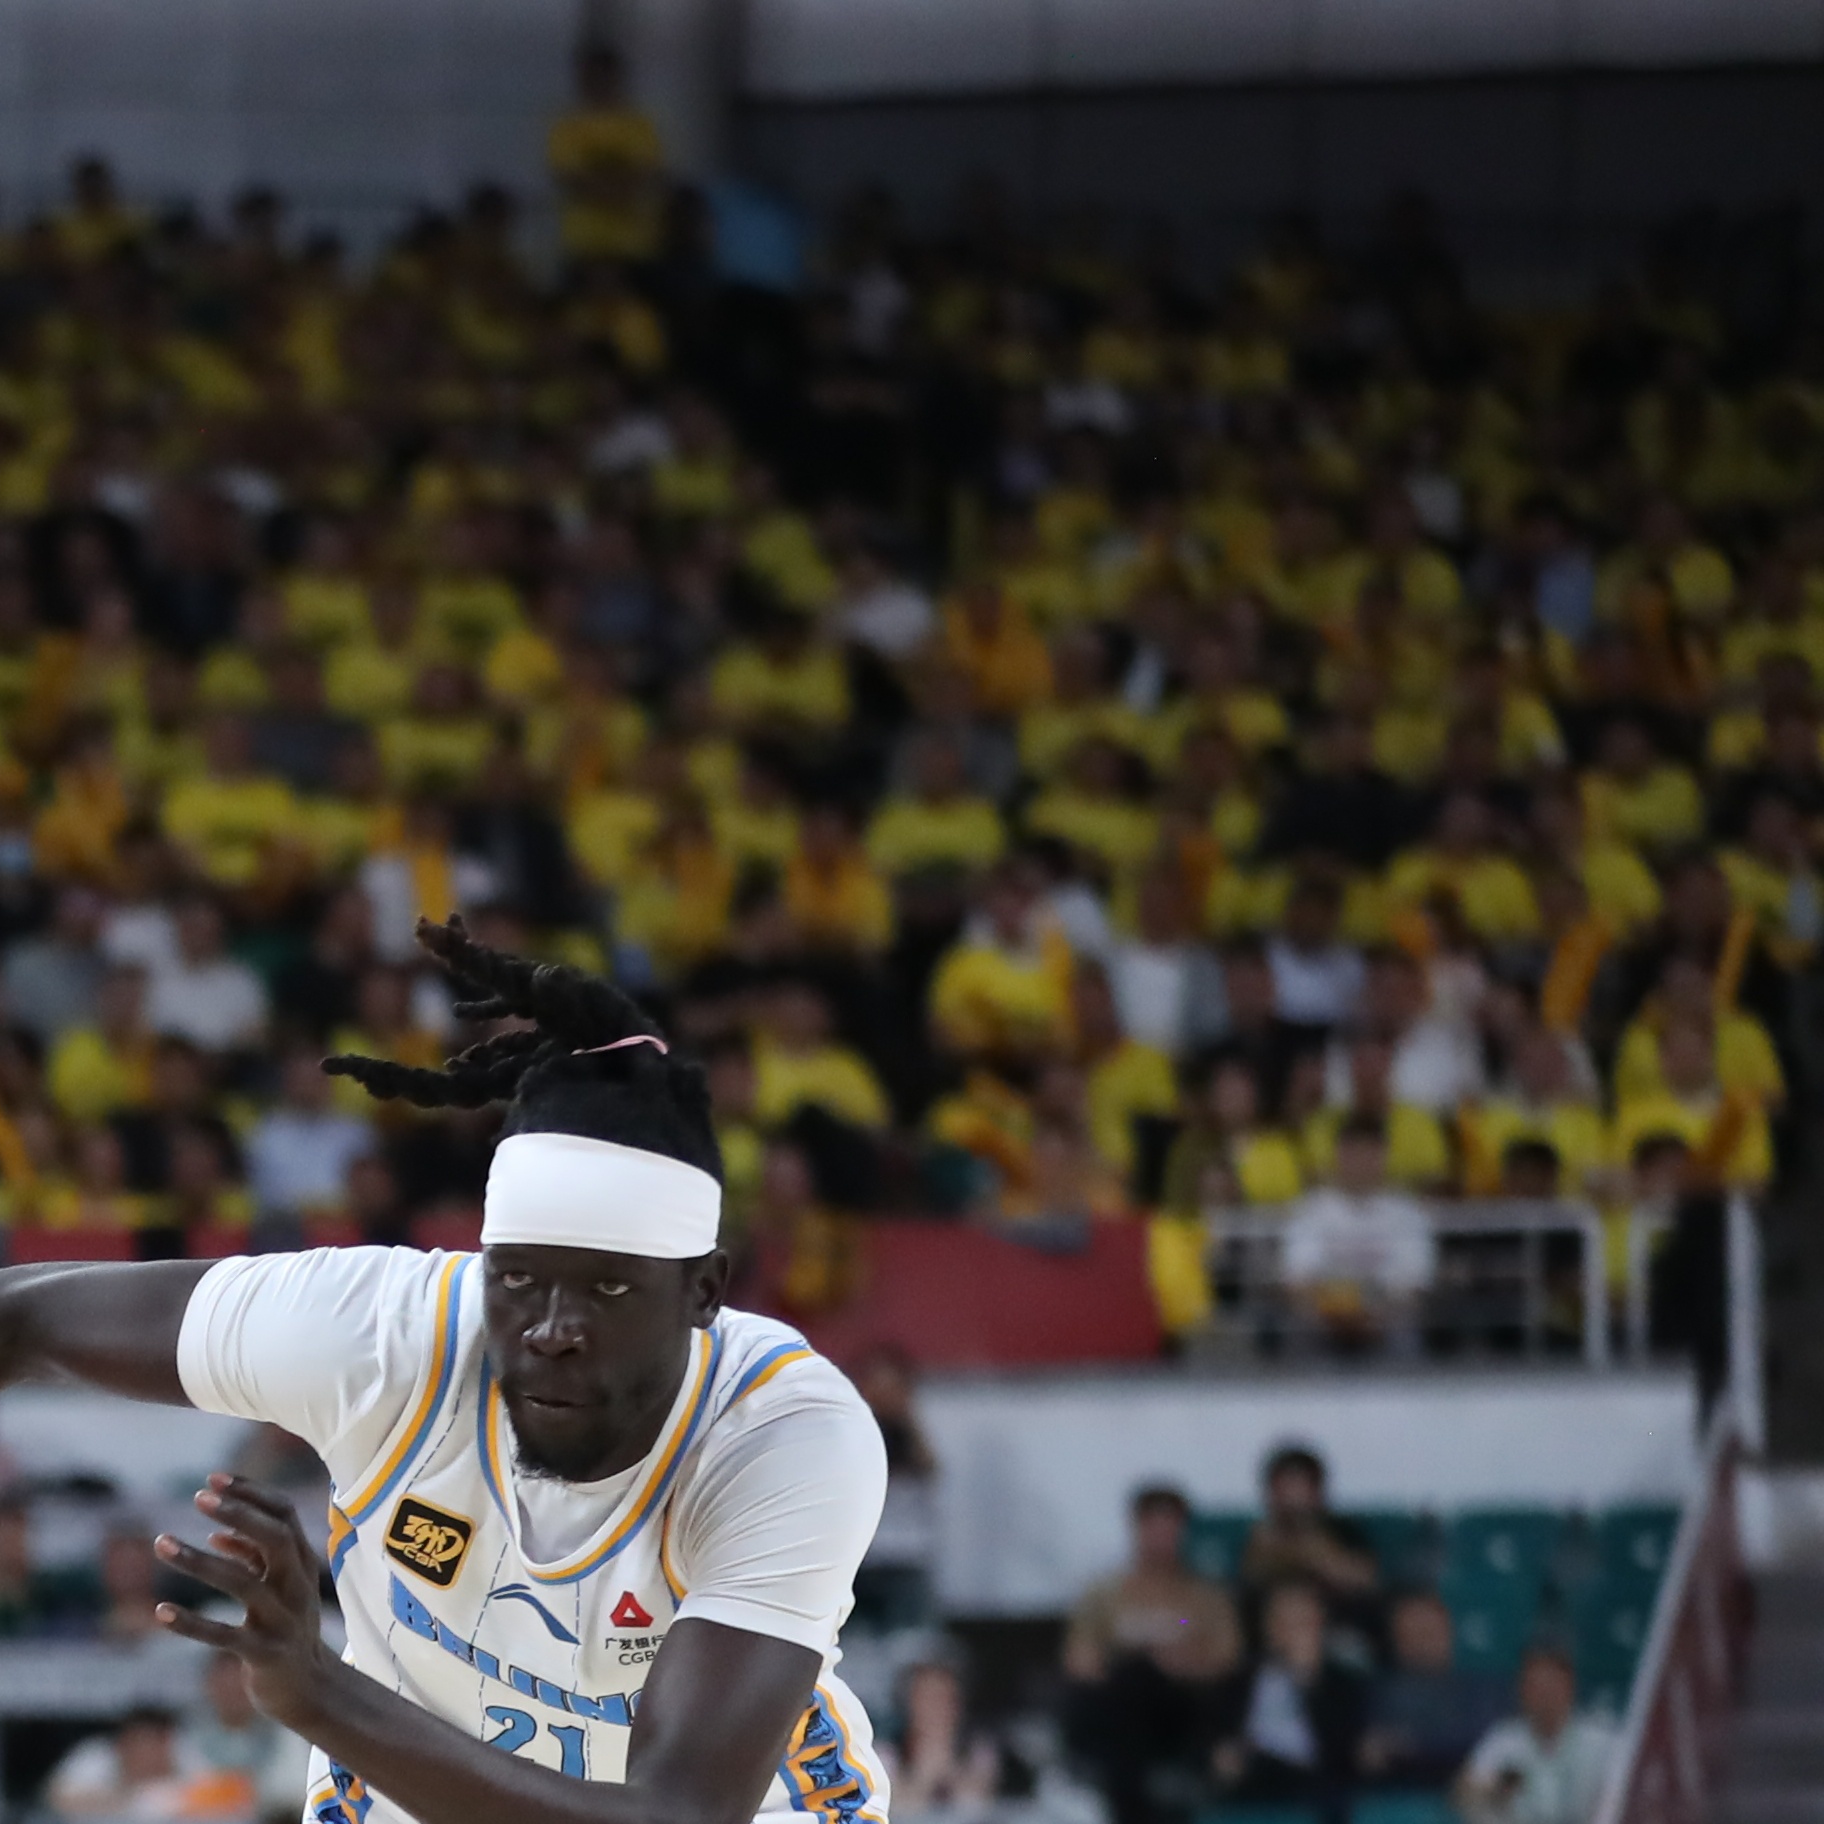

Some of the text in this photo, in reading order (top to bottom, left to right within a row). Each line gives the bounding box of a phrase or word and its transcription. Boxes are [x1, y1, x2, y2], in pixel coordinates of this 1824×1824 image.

[388, 1570, 643, 1727] BEIJIN
[618, 1650, 656, 1666] CGB
[484, 1705, 586, 1781] 21
